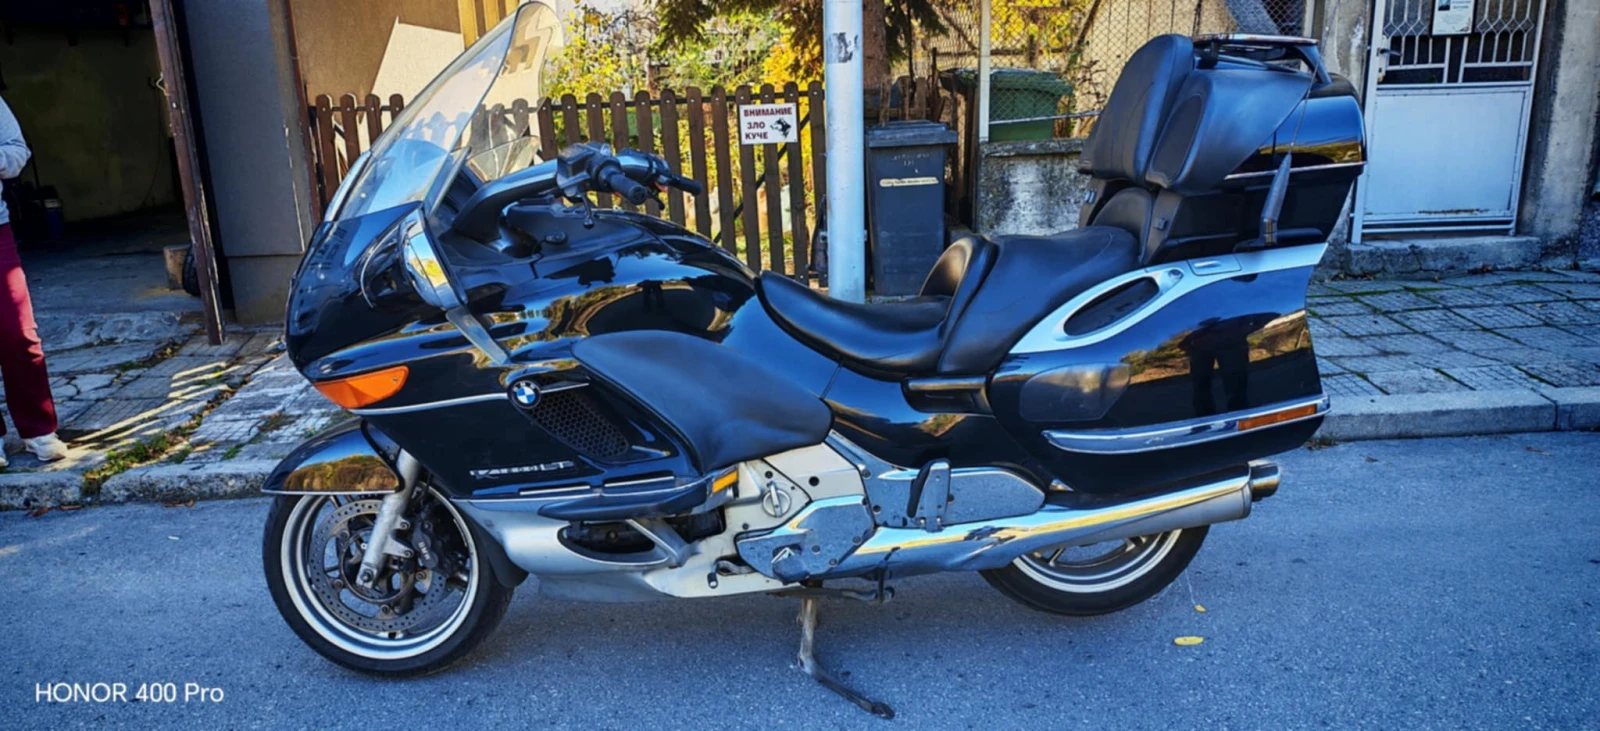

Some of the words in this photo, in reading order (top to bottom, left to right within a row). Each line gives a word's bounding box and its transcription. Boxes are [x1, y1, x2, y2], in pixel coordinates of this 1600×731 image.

[743, 107, 792, 117] ВНИМАНИЕ
[747, 121, 765, 130] ЗЛО
[745, 132, 768, 140] КУЧЕ
